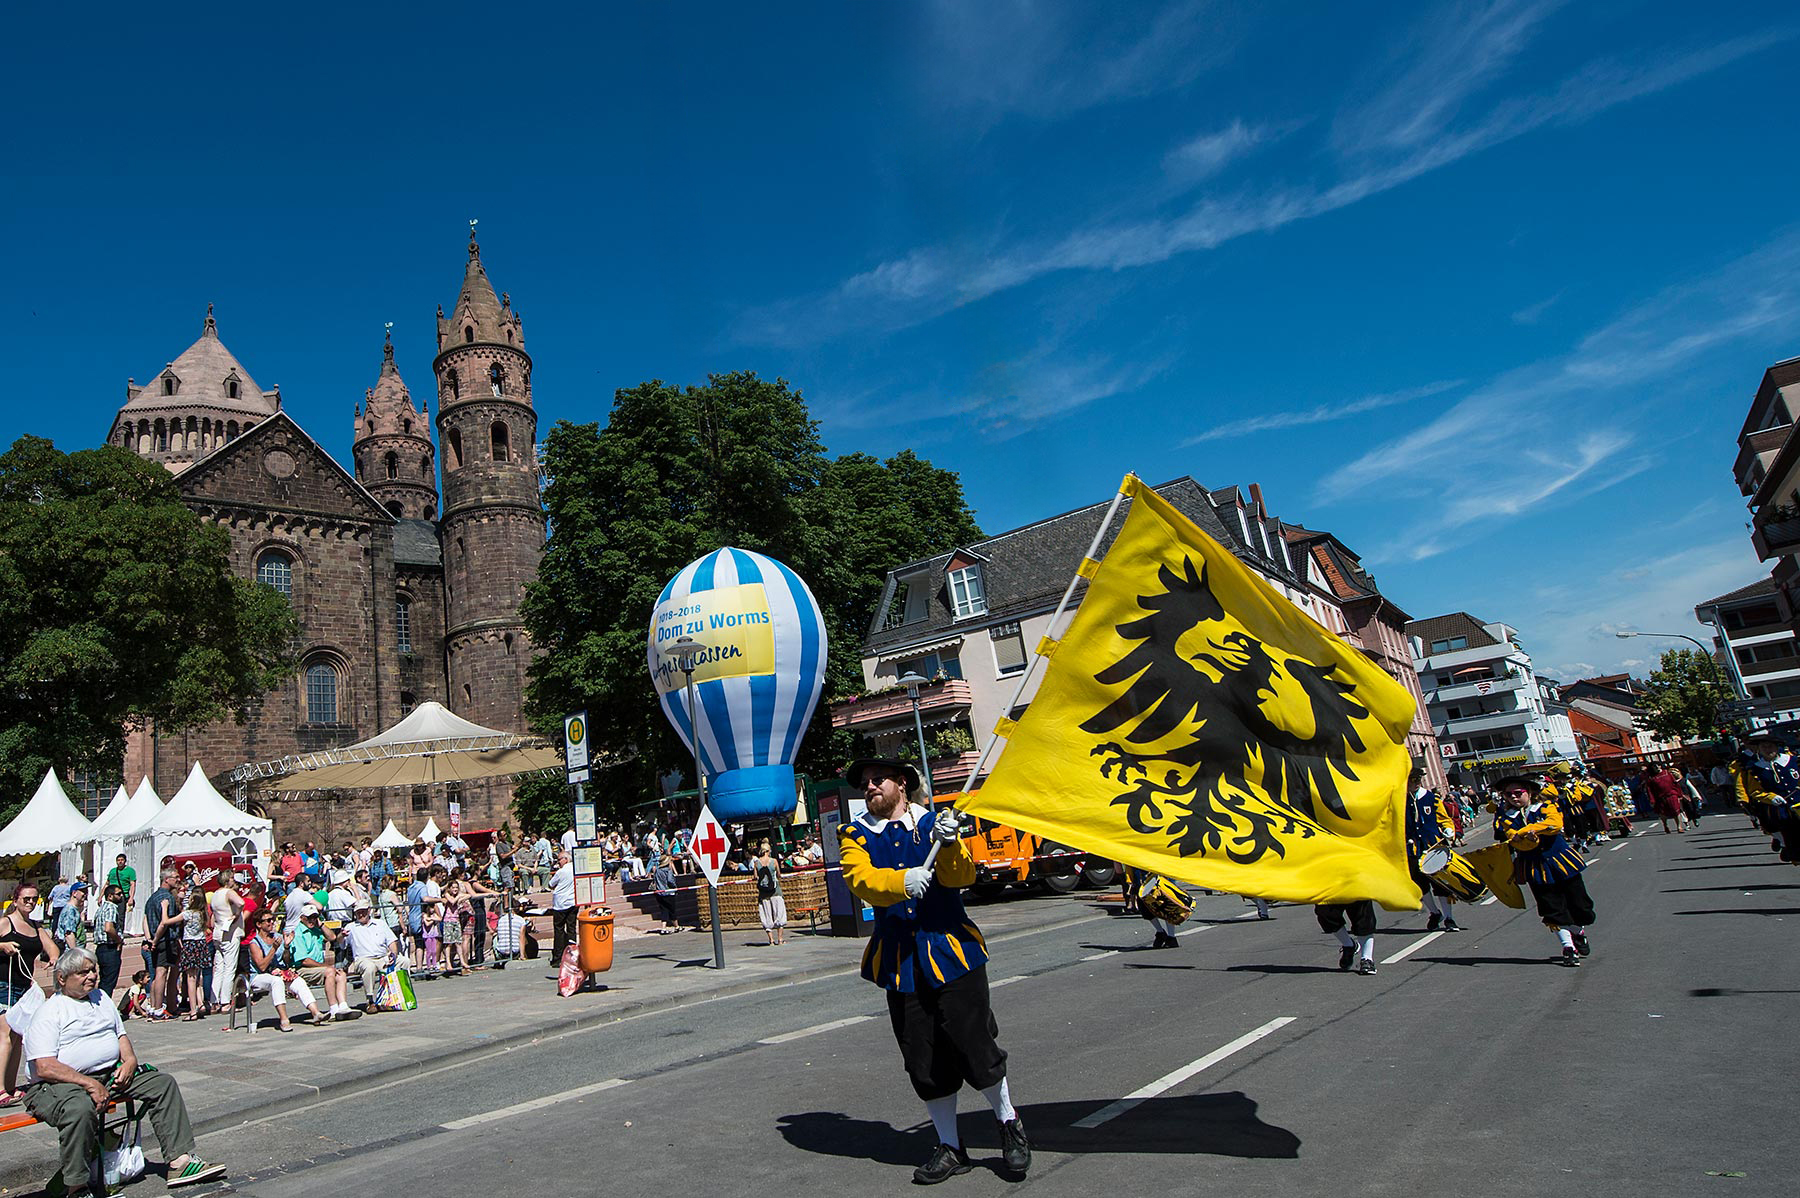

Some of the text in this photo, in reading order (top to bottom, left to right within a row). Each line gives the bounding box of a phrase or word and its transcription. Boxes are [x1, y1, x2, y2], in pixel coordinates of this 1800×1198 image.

[657, 611, 770, 643] Dom zu Worms
